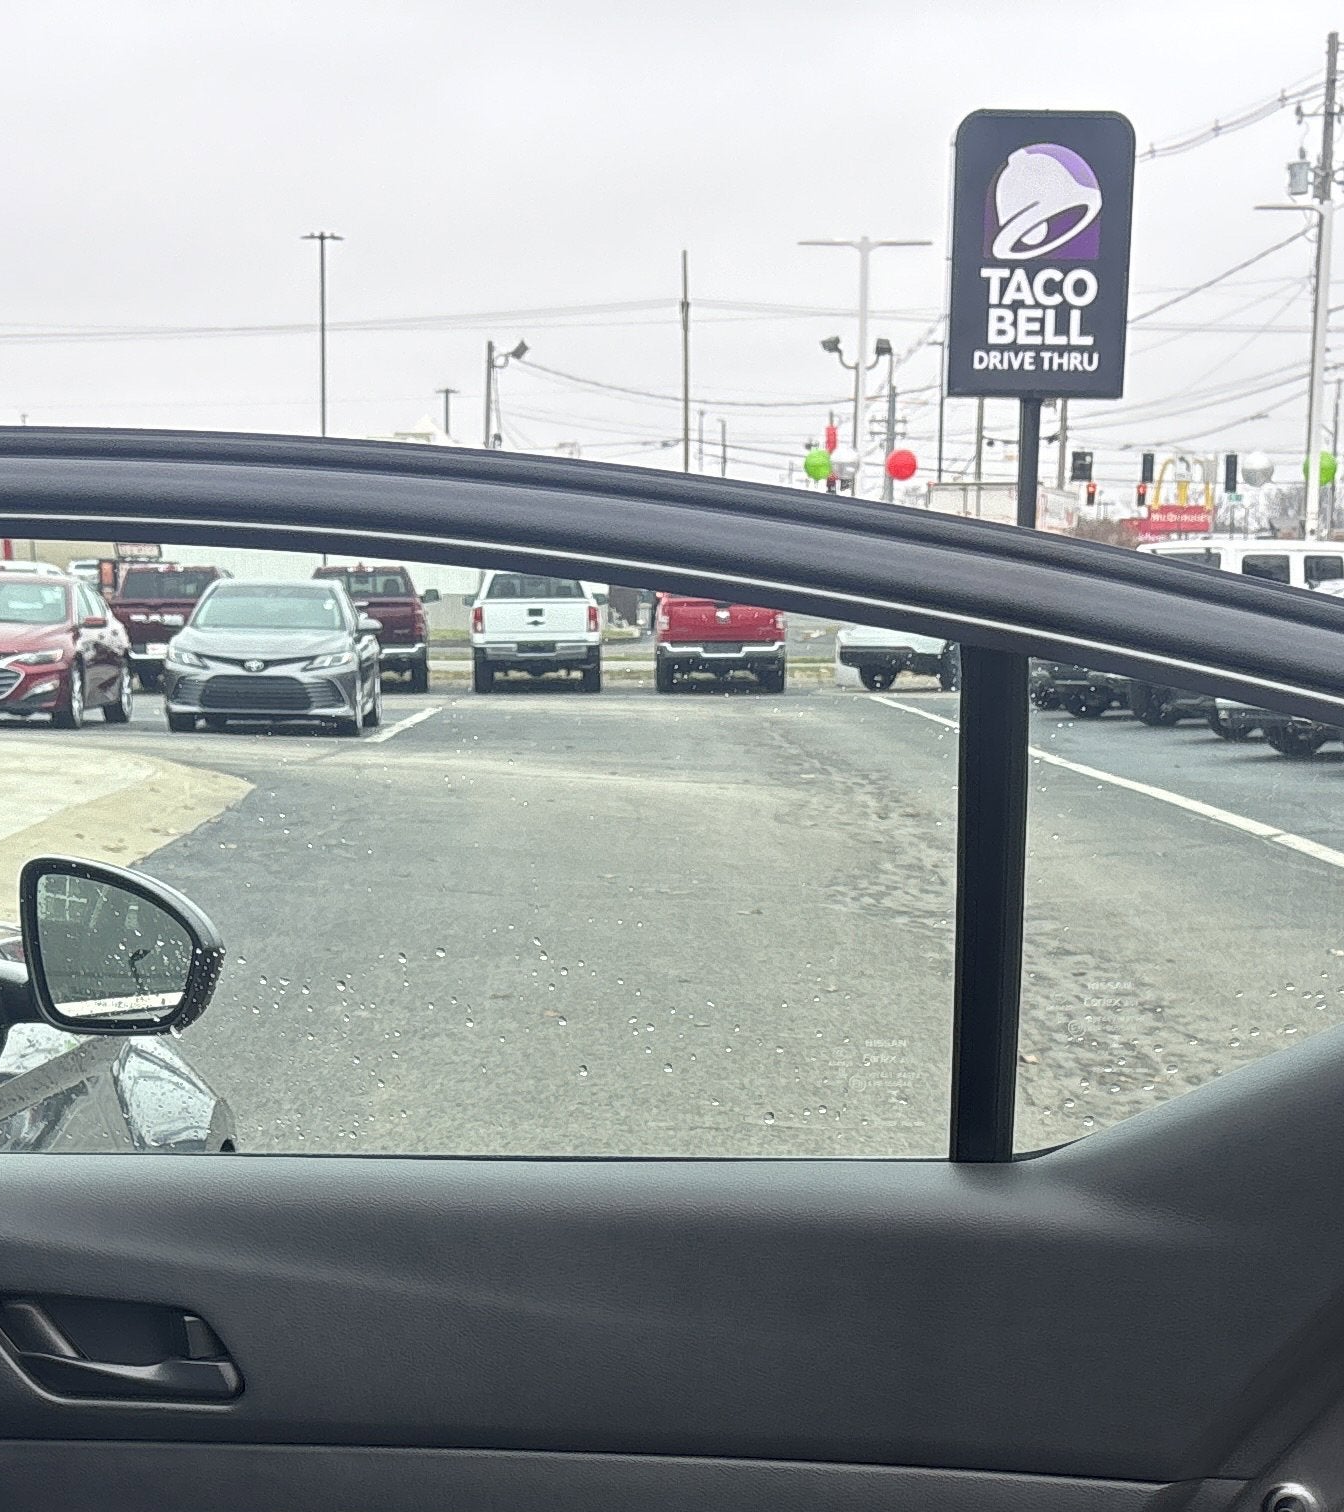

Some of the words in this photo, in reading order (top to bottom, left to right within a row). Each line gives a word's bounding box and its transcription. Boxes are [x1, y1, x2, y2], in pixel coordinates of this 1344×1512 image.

[979, 267, 1098, 307] TACO
[987, 308, 1095, 346] BELL
[972, 350, 1037, 371] DRIVE
[1041, 351, 1099, 372] THRU
